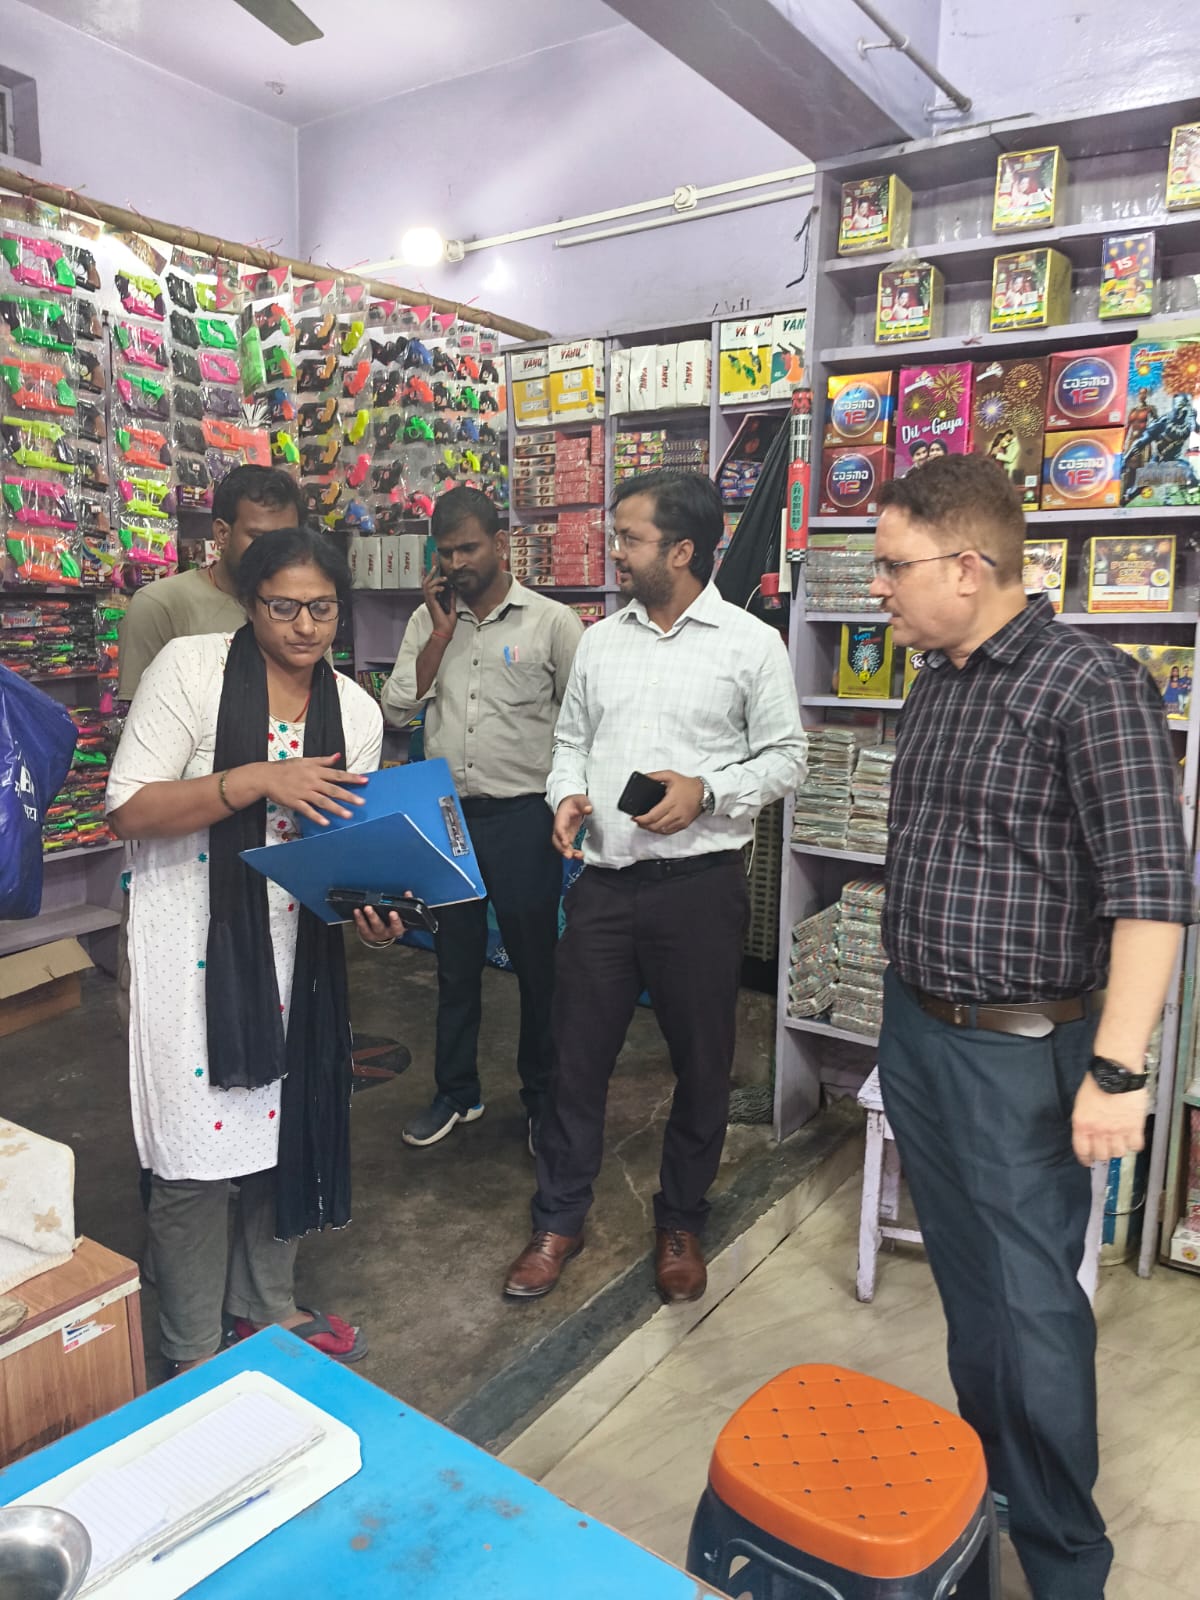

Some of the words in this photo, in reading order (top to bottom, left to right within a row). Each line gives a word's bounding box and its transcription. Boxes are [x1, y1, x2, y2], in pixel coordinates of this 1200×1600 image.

[1115, 257, 1133, 270] 15
[1070, 387, 1099, 404] 12
[844, 410, 867, 425] 12
[902, 425, 919, 444] Dil
[932, 417, 965, 435] Gaya
[1065, 469, 1095, 485] 12
[837, 480, 860, 495] 12
